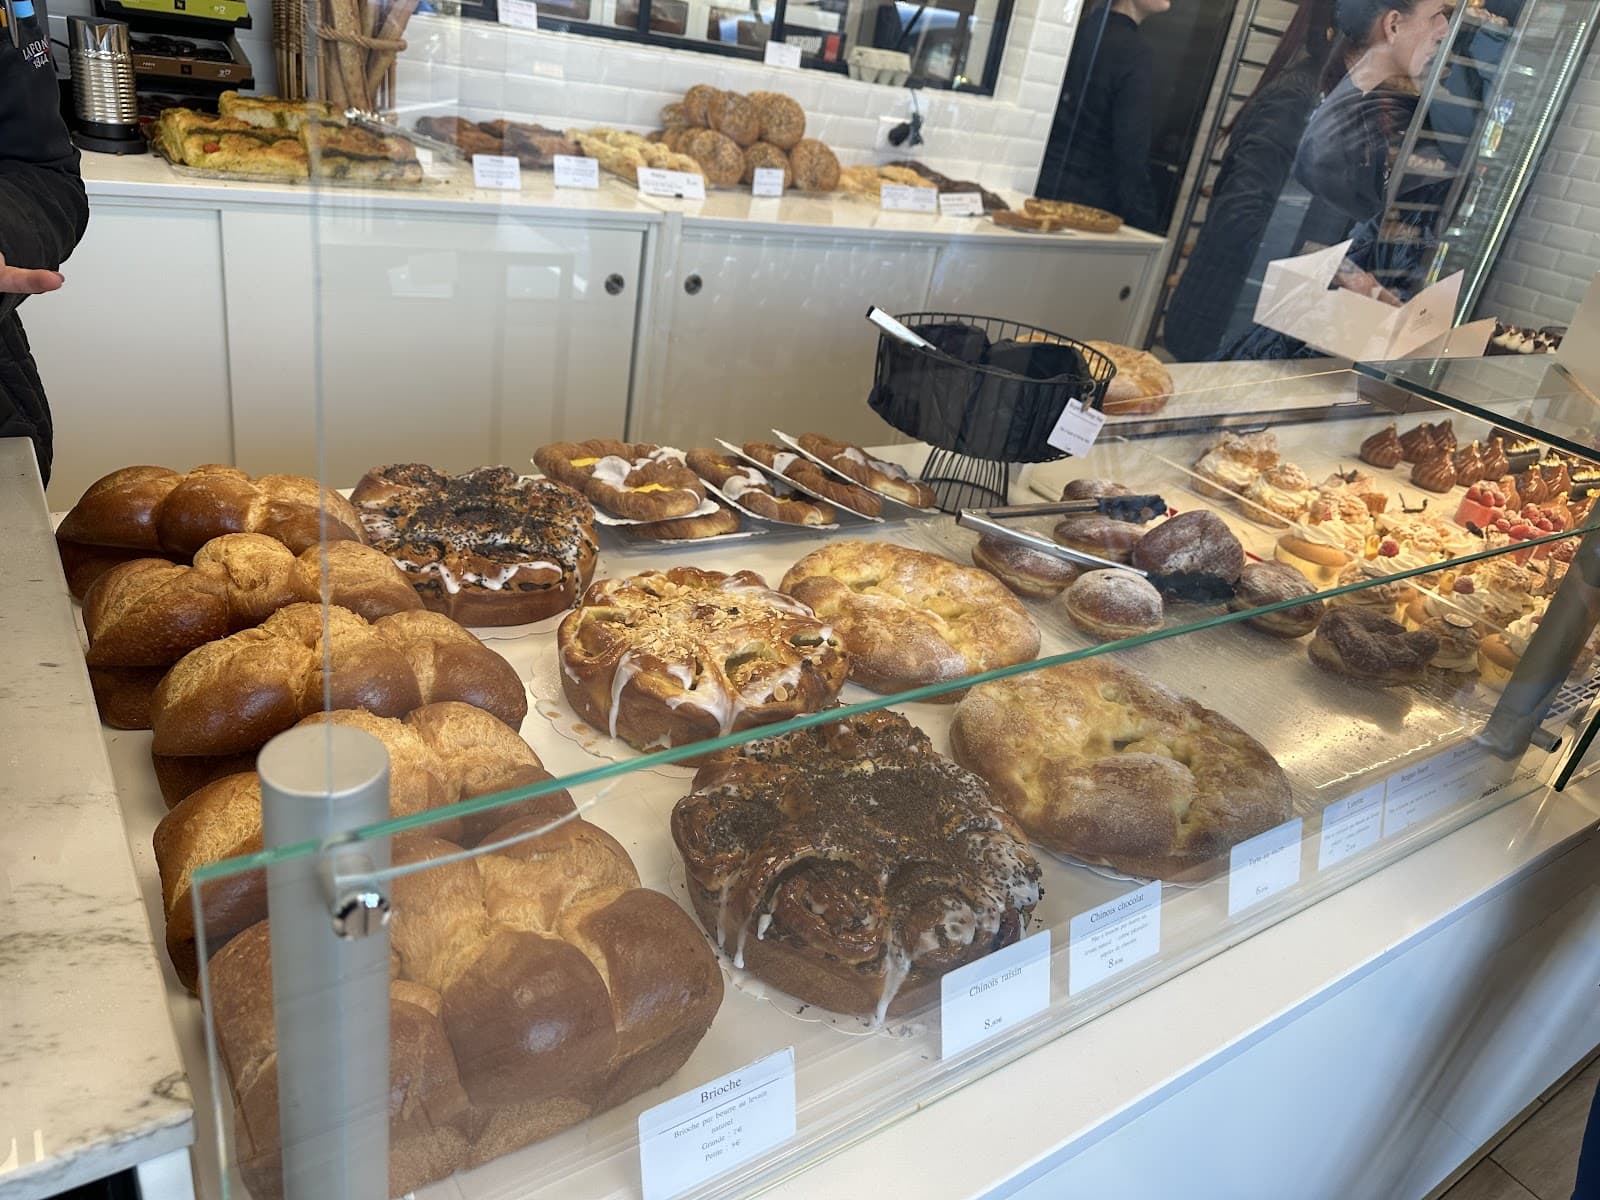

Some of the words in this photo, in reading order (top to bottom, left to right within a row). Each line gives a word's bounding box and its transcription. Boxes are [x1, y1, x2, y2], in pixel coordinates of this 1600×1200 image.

[1090, 907, 1116, 923] Chinois
[1117, 894, 1144, 911] chocolat
[969, 977, 999, 997] Chinois
[1001, 967, 1022, 982] raisin
[700, 1079, 742, 1104] Brioche
[674, 1122, 700, 1138] Brioche
[715, 1105, 736, 1119] beurre
[711, 1118, 734, 1134] naturel
[701, 1135, 725, 1150] Grande
